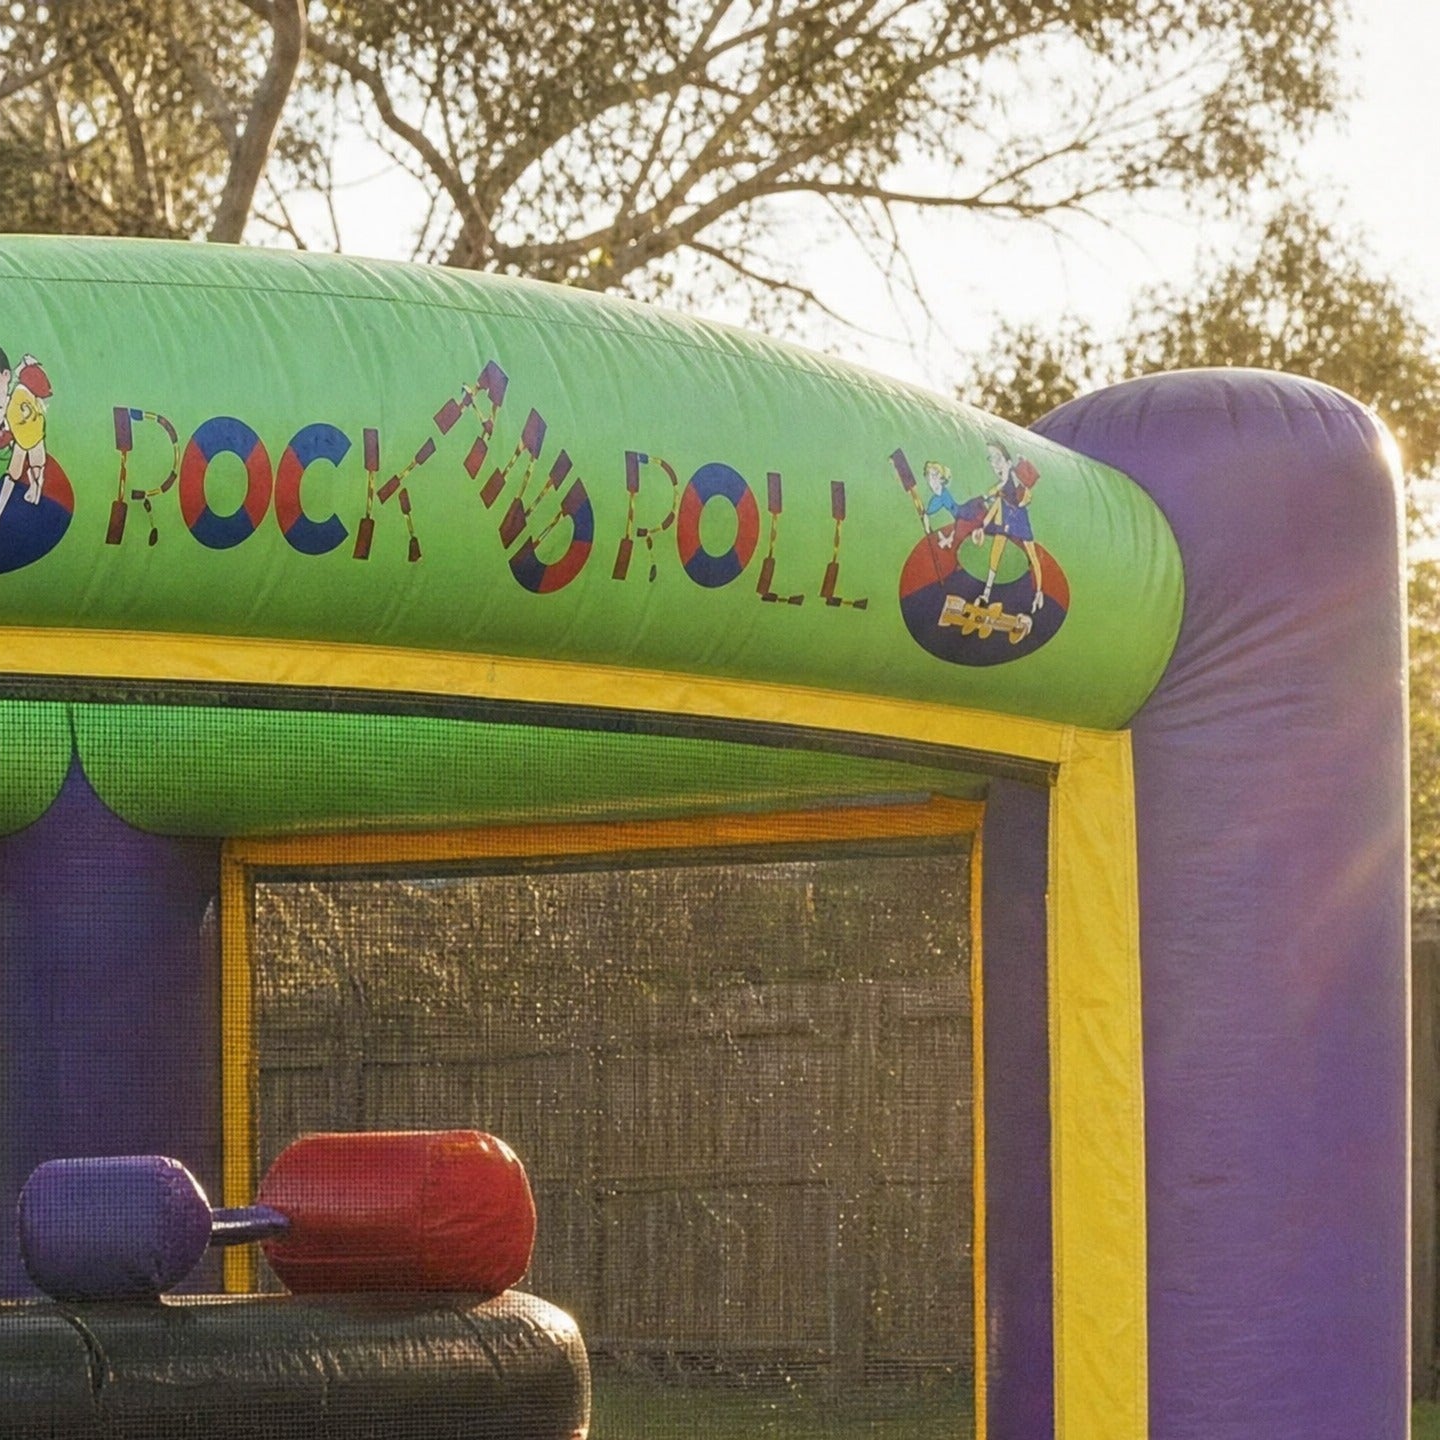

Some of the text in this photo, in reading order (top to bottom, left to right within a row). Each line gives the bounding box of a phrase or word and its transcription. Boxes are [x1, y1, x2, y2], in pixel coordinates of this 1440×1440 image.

[105, 359, 869, 611] ROCK AND ROLL
